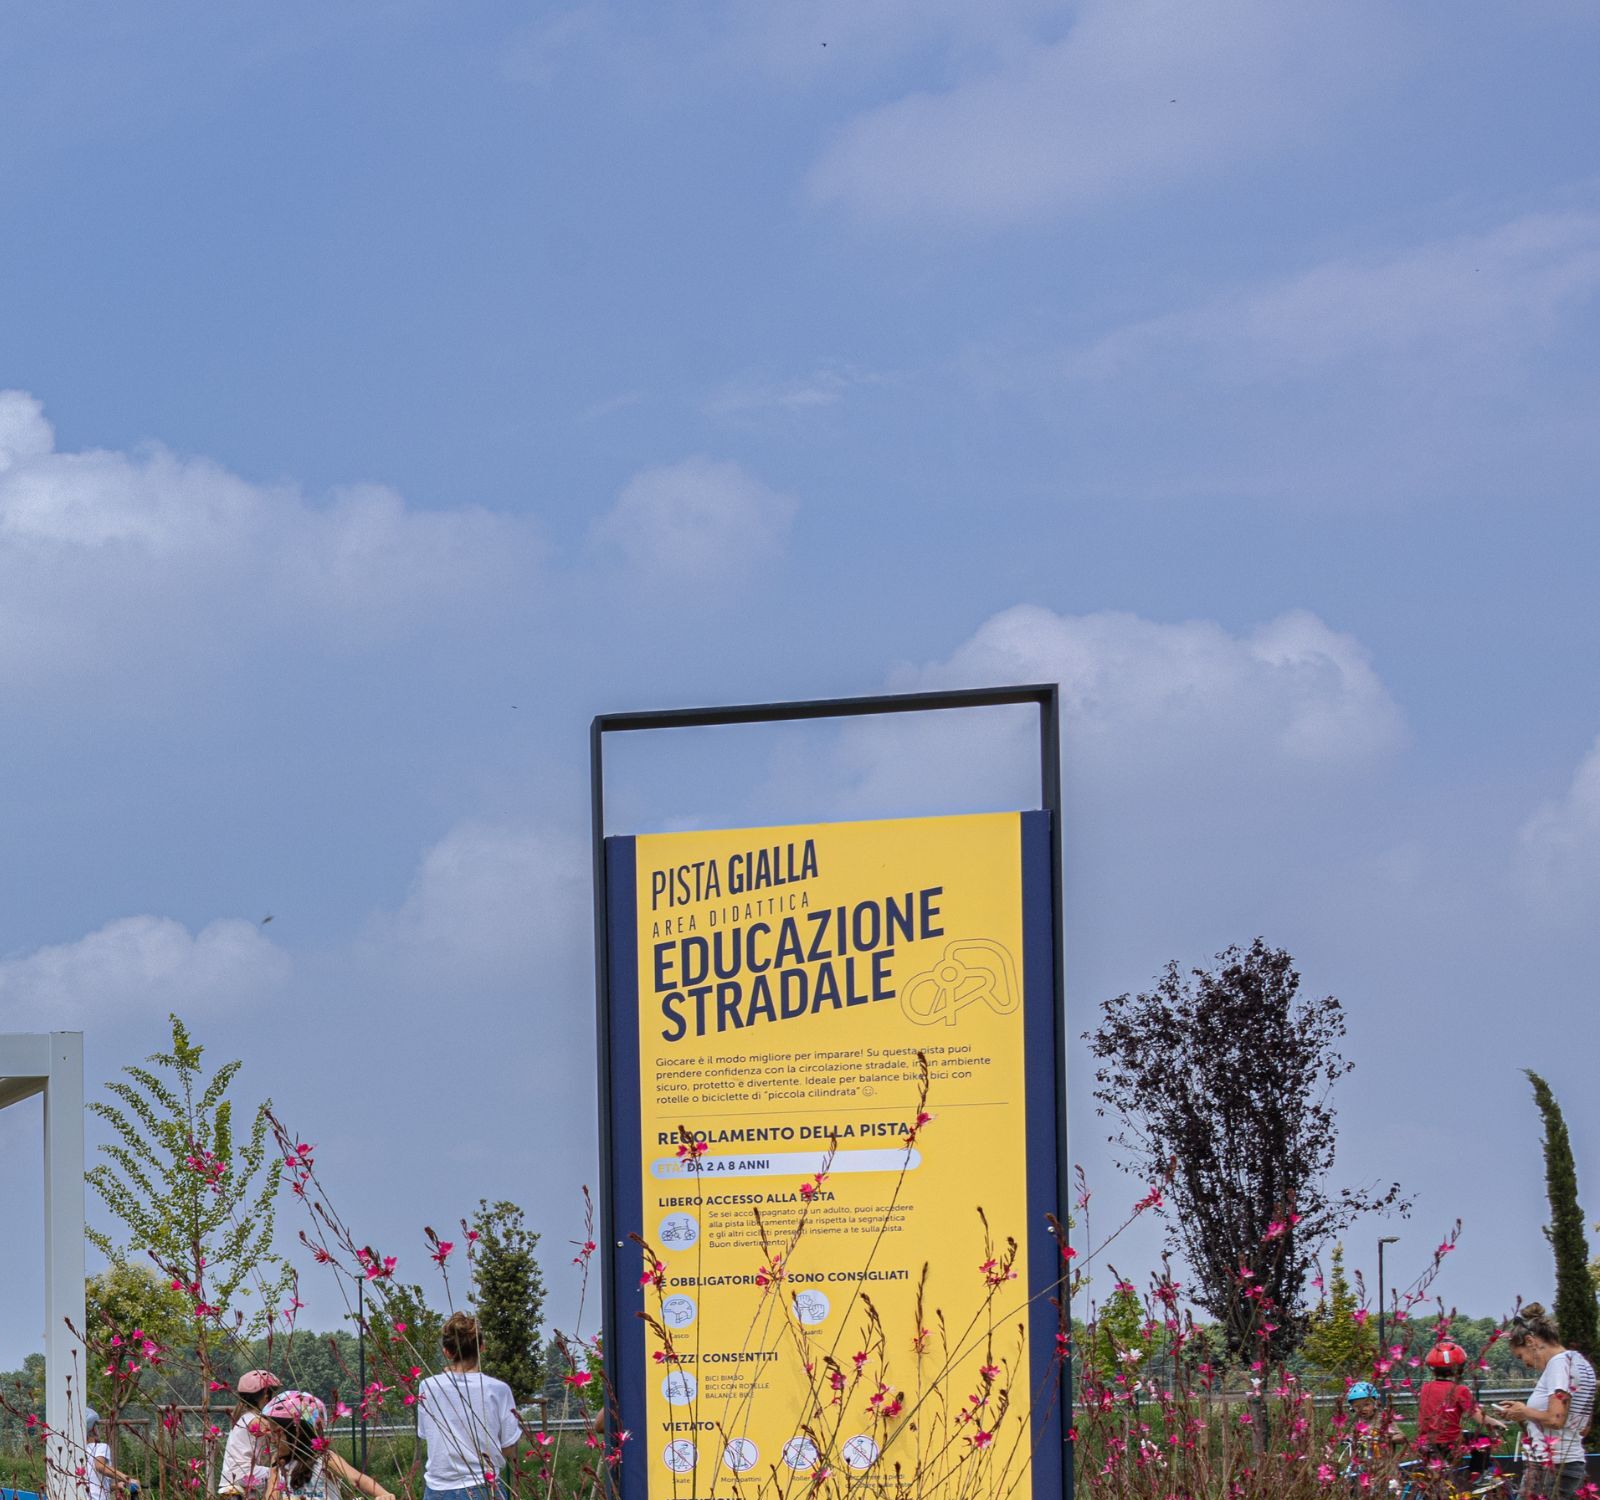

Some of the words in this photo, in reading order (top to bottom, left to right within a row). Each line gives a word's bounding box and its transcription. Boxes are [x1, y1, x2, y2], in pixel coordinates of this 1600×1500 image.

[651, 859, 721, 911] PISTA
[728, 839, 819, 895] GIALLA
[652, 914, 697, 939] AREA
[709, 891, 810, 927] DIDATTICA
[653, 885, 945, 993] EDUCAZIONE
[661, 949, 896, 1042] STRADALE
[656, 1057, 695, 1067] Giocare
[698, 1057, 705, 1065] è
[707, 1055, 713, 1064] il
[716, 1054, 746, 1064] modo
[749, 1053, 792, 1064] migliore
[794, 1053, 812, 1064] per
[814, 1049, 863, 1060] imparare!
[867, 1048, 880, 1057] Su
[882, 1047, 917, 1059] questa
[947, 1044, 972, 1054] puoi
[656, 1070, 702, 1080] prendere
[704, 1067, 762, 1078] confidenza
[764, 1066, 784, 1074] con
[787, 1065, 796, 1073] la
[799, 1062, 862, 1073] circolazione
[941, 1057, 991, 1066] ambiente
[693, 1080, 735, 1091] protetto
[738, 1080, 745, 1088] e
[805, 1074, 836, 1085] Ideale
[839, 1075, 856, 1086] per
[859, 1073, 899, 1083] balance
[930, 1071, 949, 1080] bici
[952, 1071, 972, 1079] con
[656, 1093, 689, 1104] rotelle
[702, 1091, 749, 1102] biciclette
[752, 1090, 761, 1100] di
[658, 1127, 794, 1145] REGOLAMENTO
[800, 1124, 855, 1139] DELLA
[860, 1122, 910, 1137] PISTA
[687, 1161, 703, 1172] DA
[707, 1161, 714, 1171] 2
[717, 1161, 725, 1171] A
[728, 1161, 735, 1170] 8
[738, 1160, 770, 1170] ANNI
[659, 1196, 703, 1207] LIBERO
[706, 1194, 764, 1206] ACCESSO
[766, 1193, 797, 1203] ALLA
[854, 1204, 874, 1214] puoi
[876, 1204, 914, 1212] accedere
[725, 1220, 744, 1229] pista
[816, 1216, 846, 1225] rispetta
[716, 1230, 726, 1239] gli
[728, 1230, 743, 1238] altri
[746, 1229, 772, 1237] ciclti
[810, 1226, 840, 1234] insieme
[709, 1240, 731, 1248] Buon
[670, 1275, 766, 1287] OBBLIGATORI
[788, 1272, 825, 1283] SONO
[828, 1270, 909, 1282] CONSIGLIATI
[703, 1352, 778, 1363] CONSENTITI
[662, 1421, 715, 1431] VIETATO
